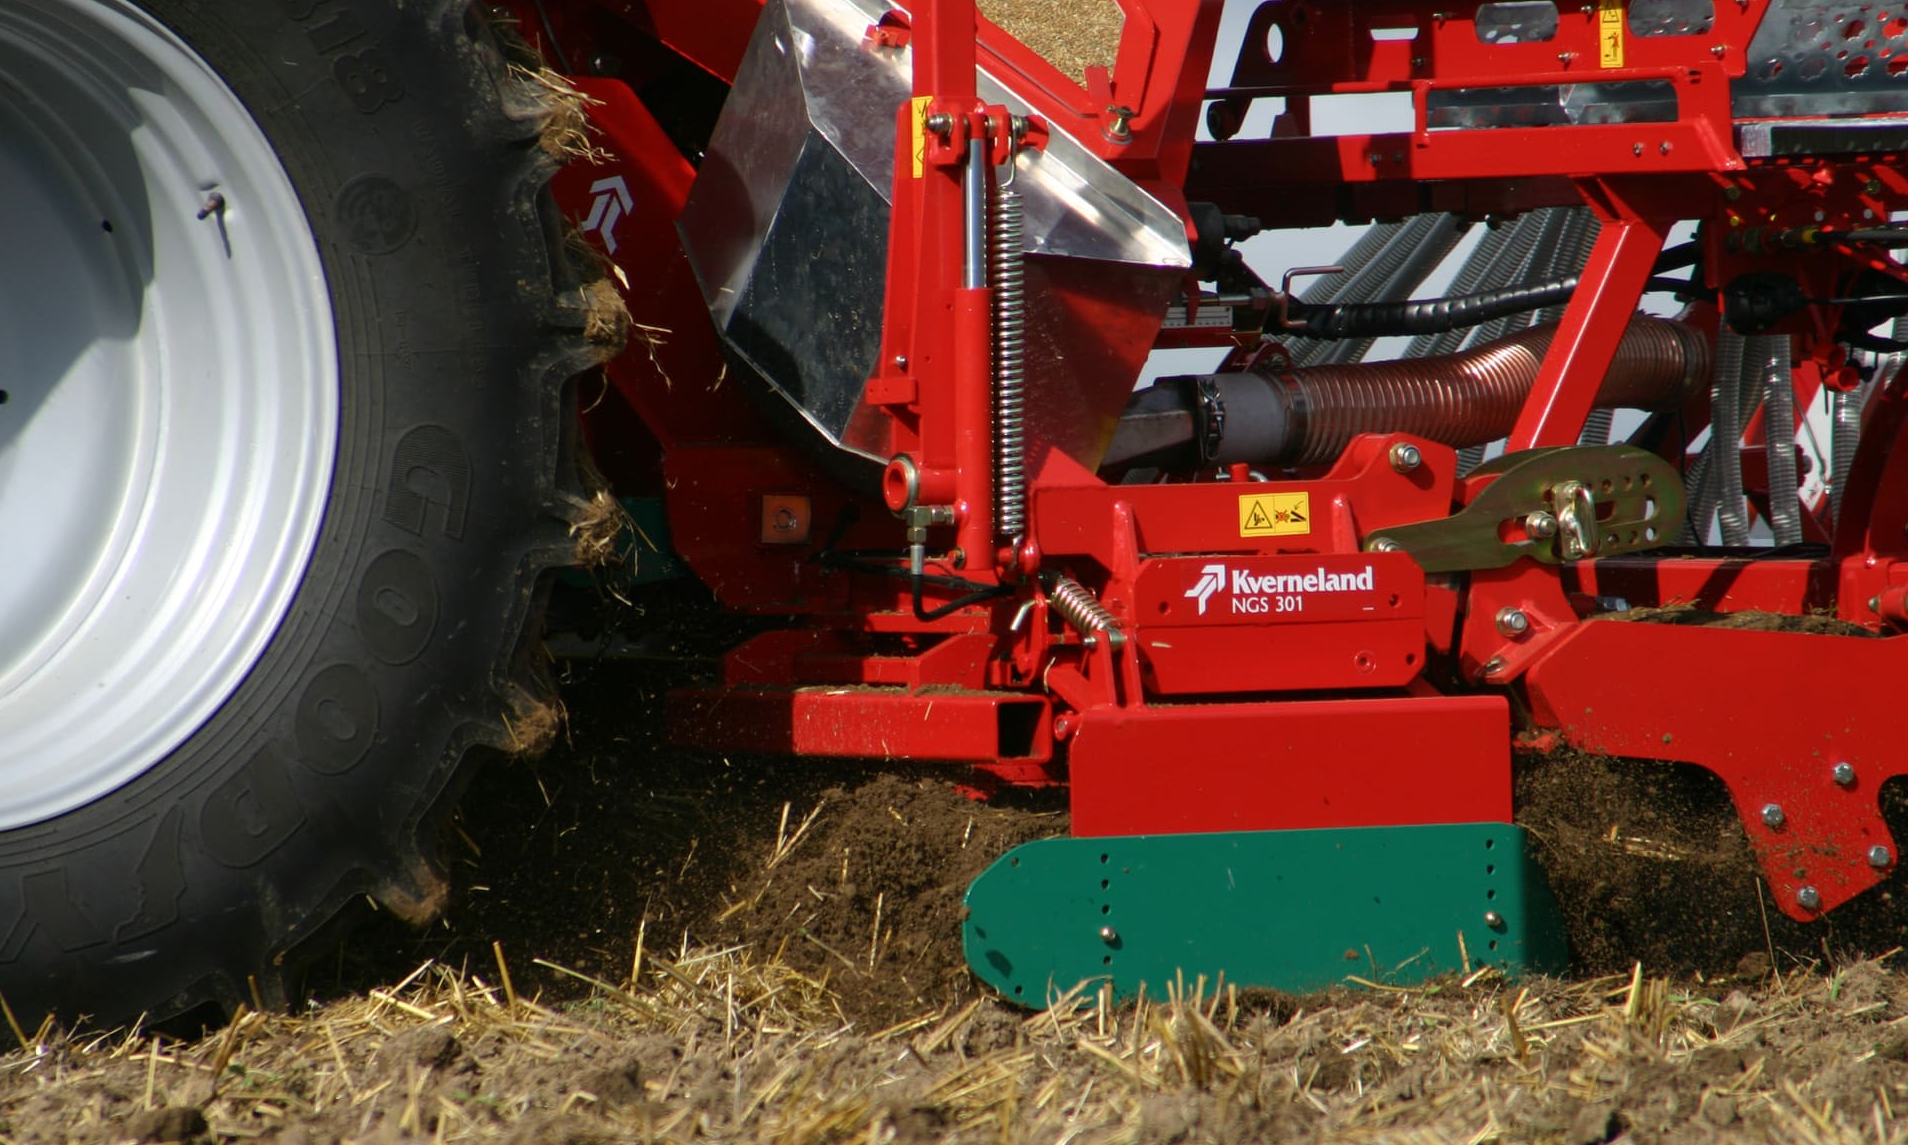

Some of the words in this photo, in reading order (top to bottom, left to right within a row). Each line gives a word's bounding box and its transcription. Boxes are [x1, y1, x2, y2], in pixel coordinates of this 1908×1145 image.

[1232, 565, 1374, 594] Kverneland
[1232, 596, 1269, 614] NGS
[1275, 595, 1303, 612] 301
